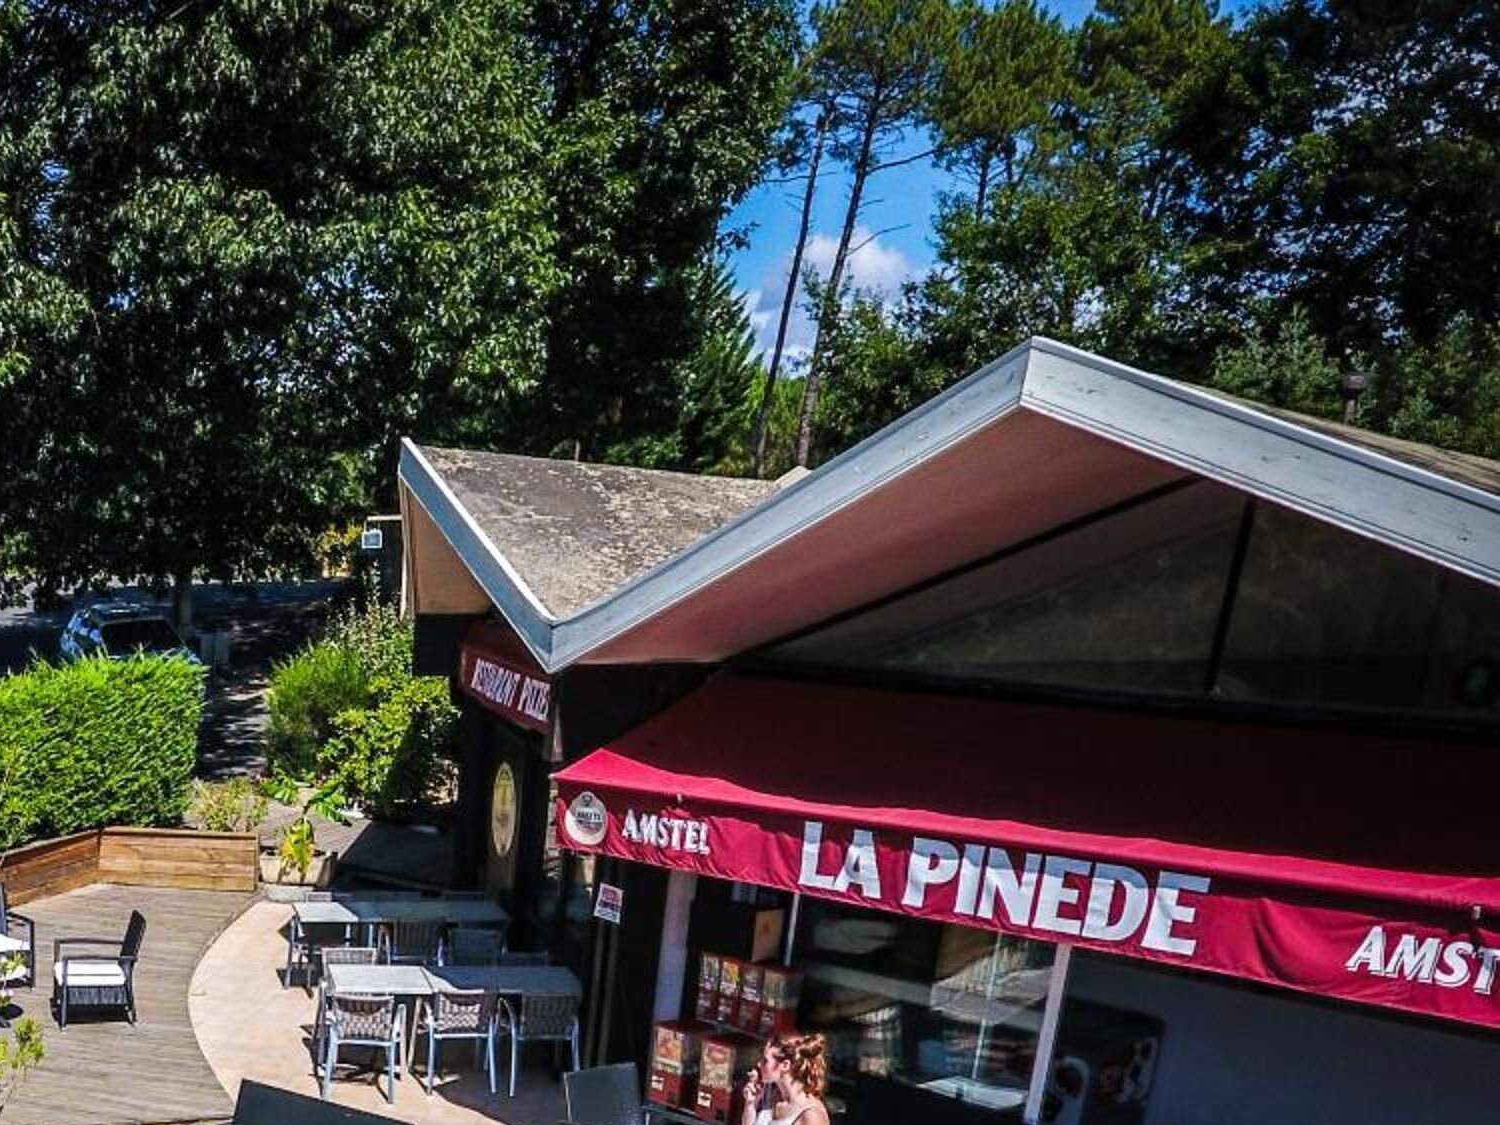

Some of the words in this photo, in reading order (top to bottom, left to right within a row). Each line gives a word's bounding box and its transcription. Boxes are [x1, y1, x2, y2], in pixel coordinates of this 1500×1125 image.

[621, 808, 711, 856] AMSTEL
[798, 821, 881, 899] LA
[901, 836, 1211, 956] PINEDE
